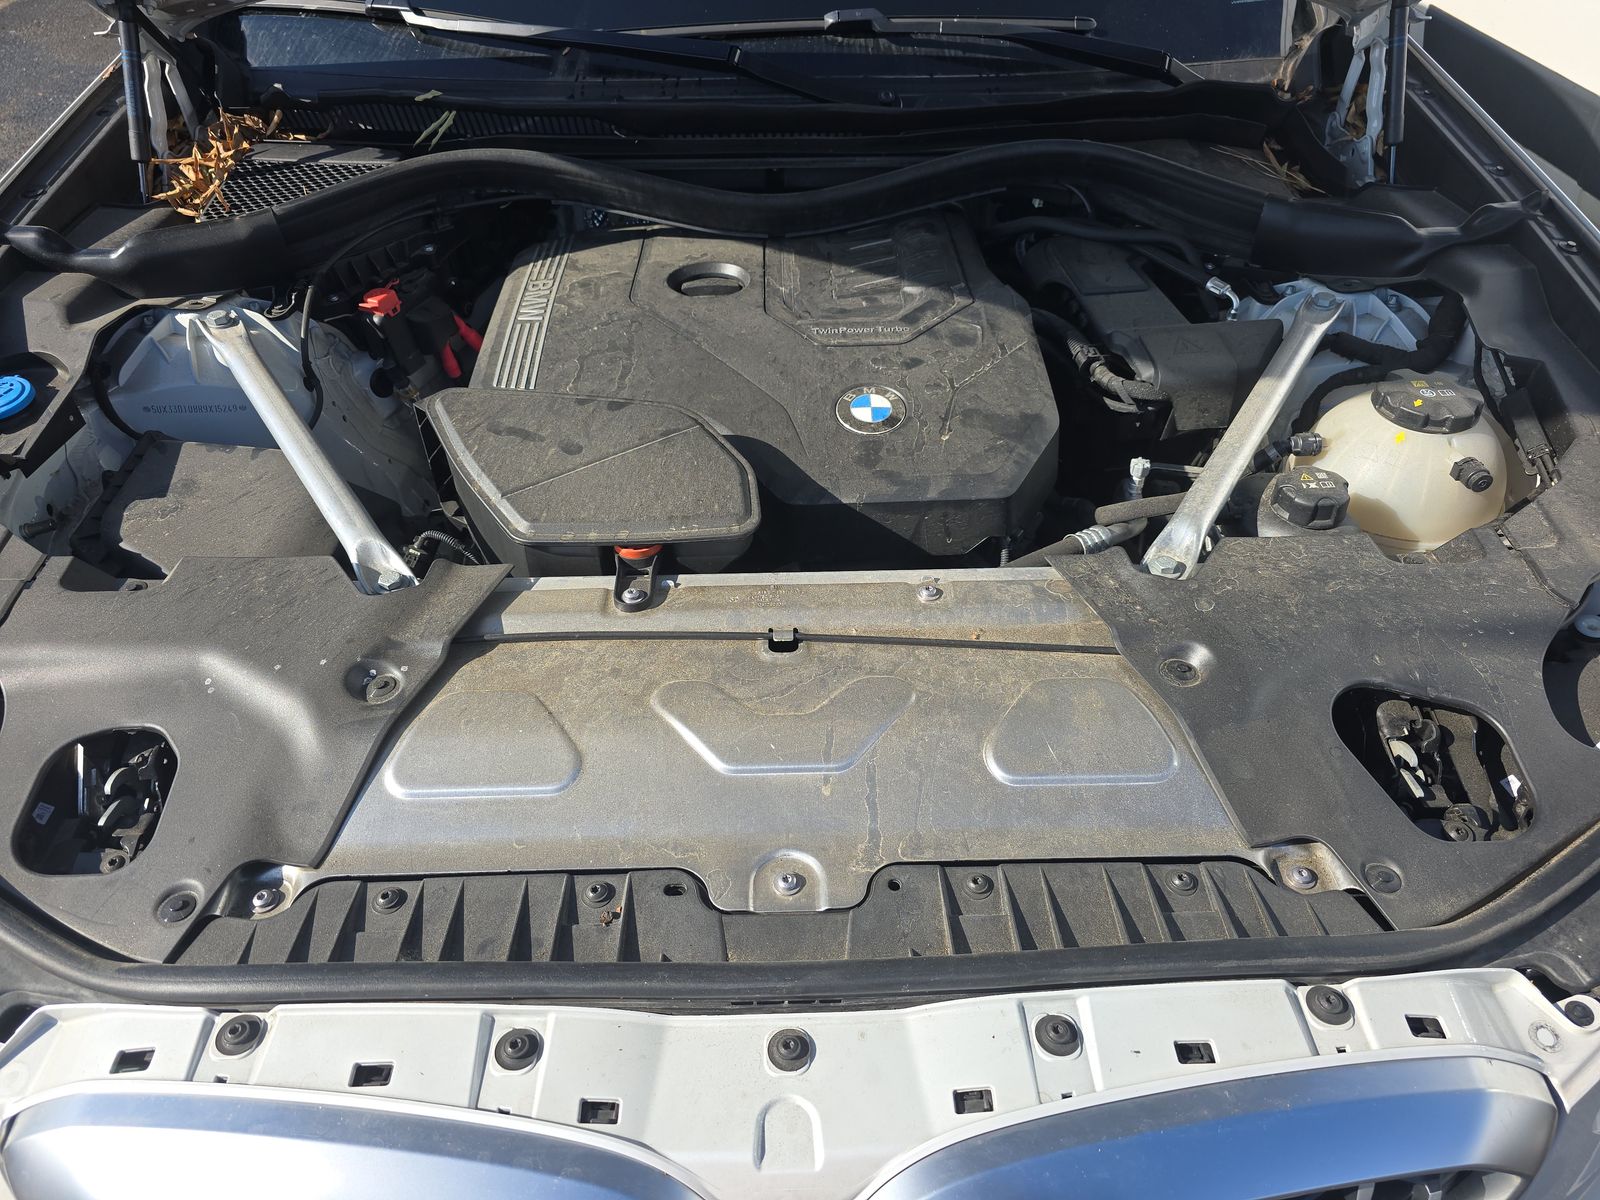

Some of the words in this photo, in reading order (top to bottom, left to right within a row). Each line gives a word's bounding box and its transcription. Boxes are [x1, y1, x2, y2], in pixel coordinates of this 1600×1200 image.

[517, 280, 555, 321] BMW
[813, 326, 875, 334] TwinPower
[878, 325, 910, 333] Turbo
[843, 387, 899, 402] BMW
